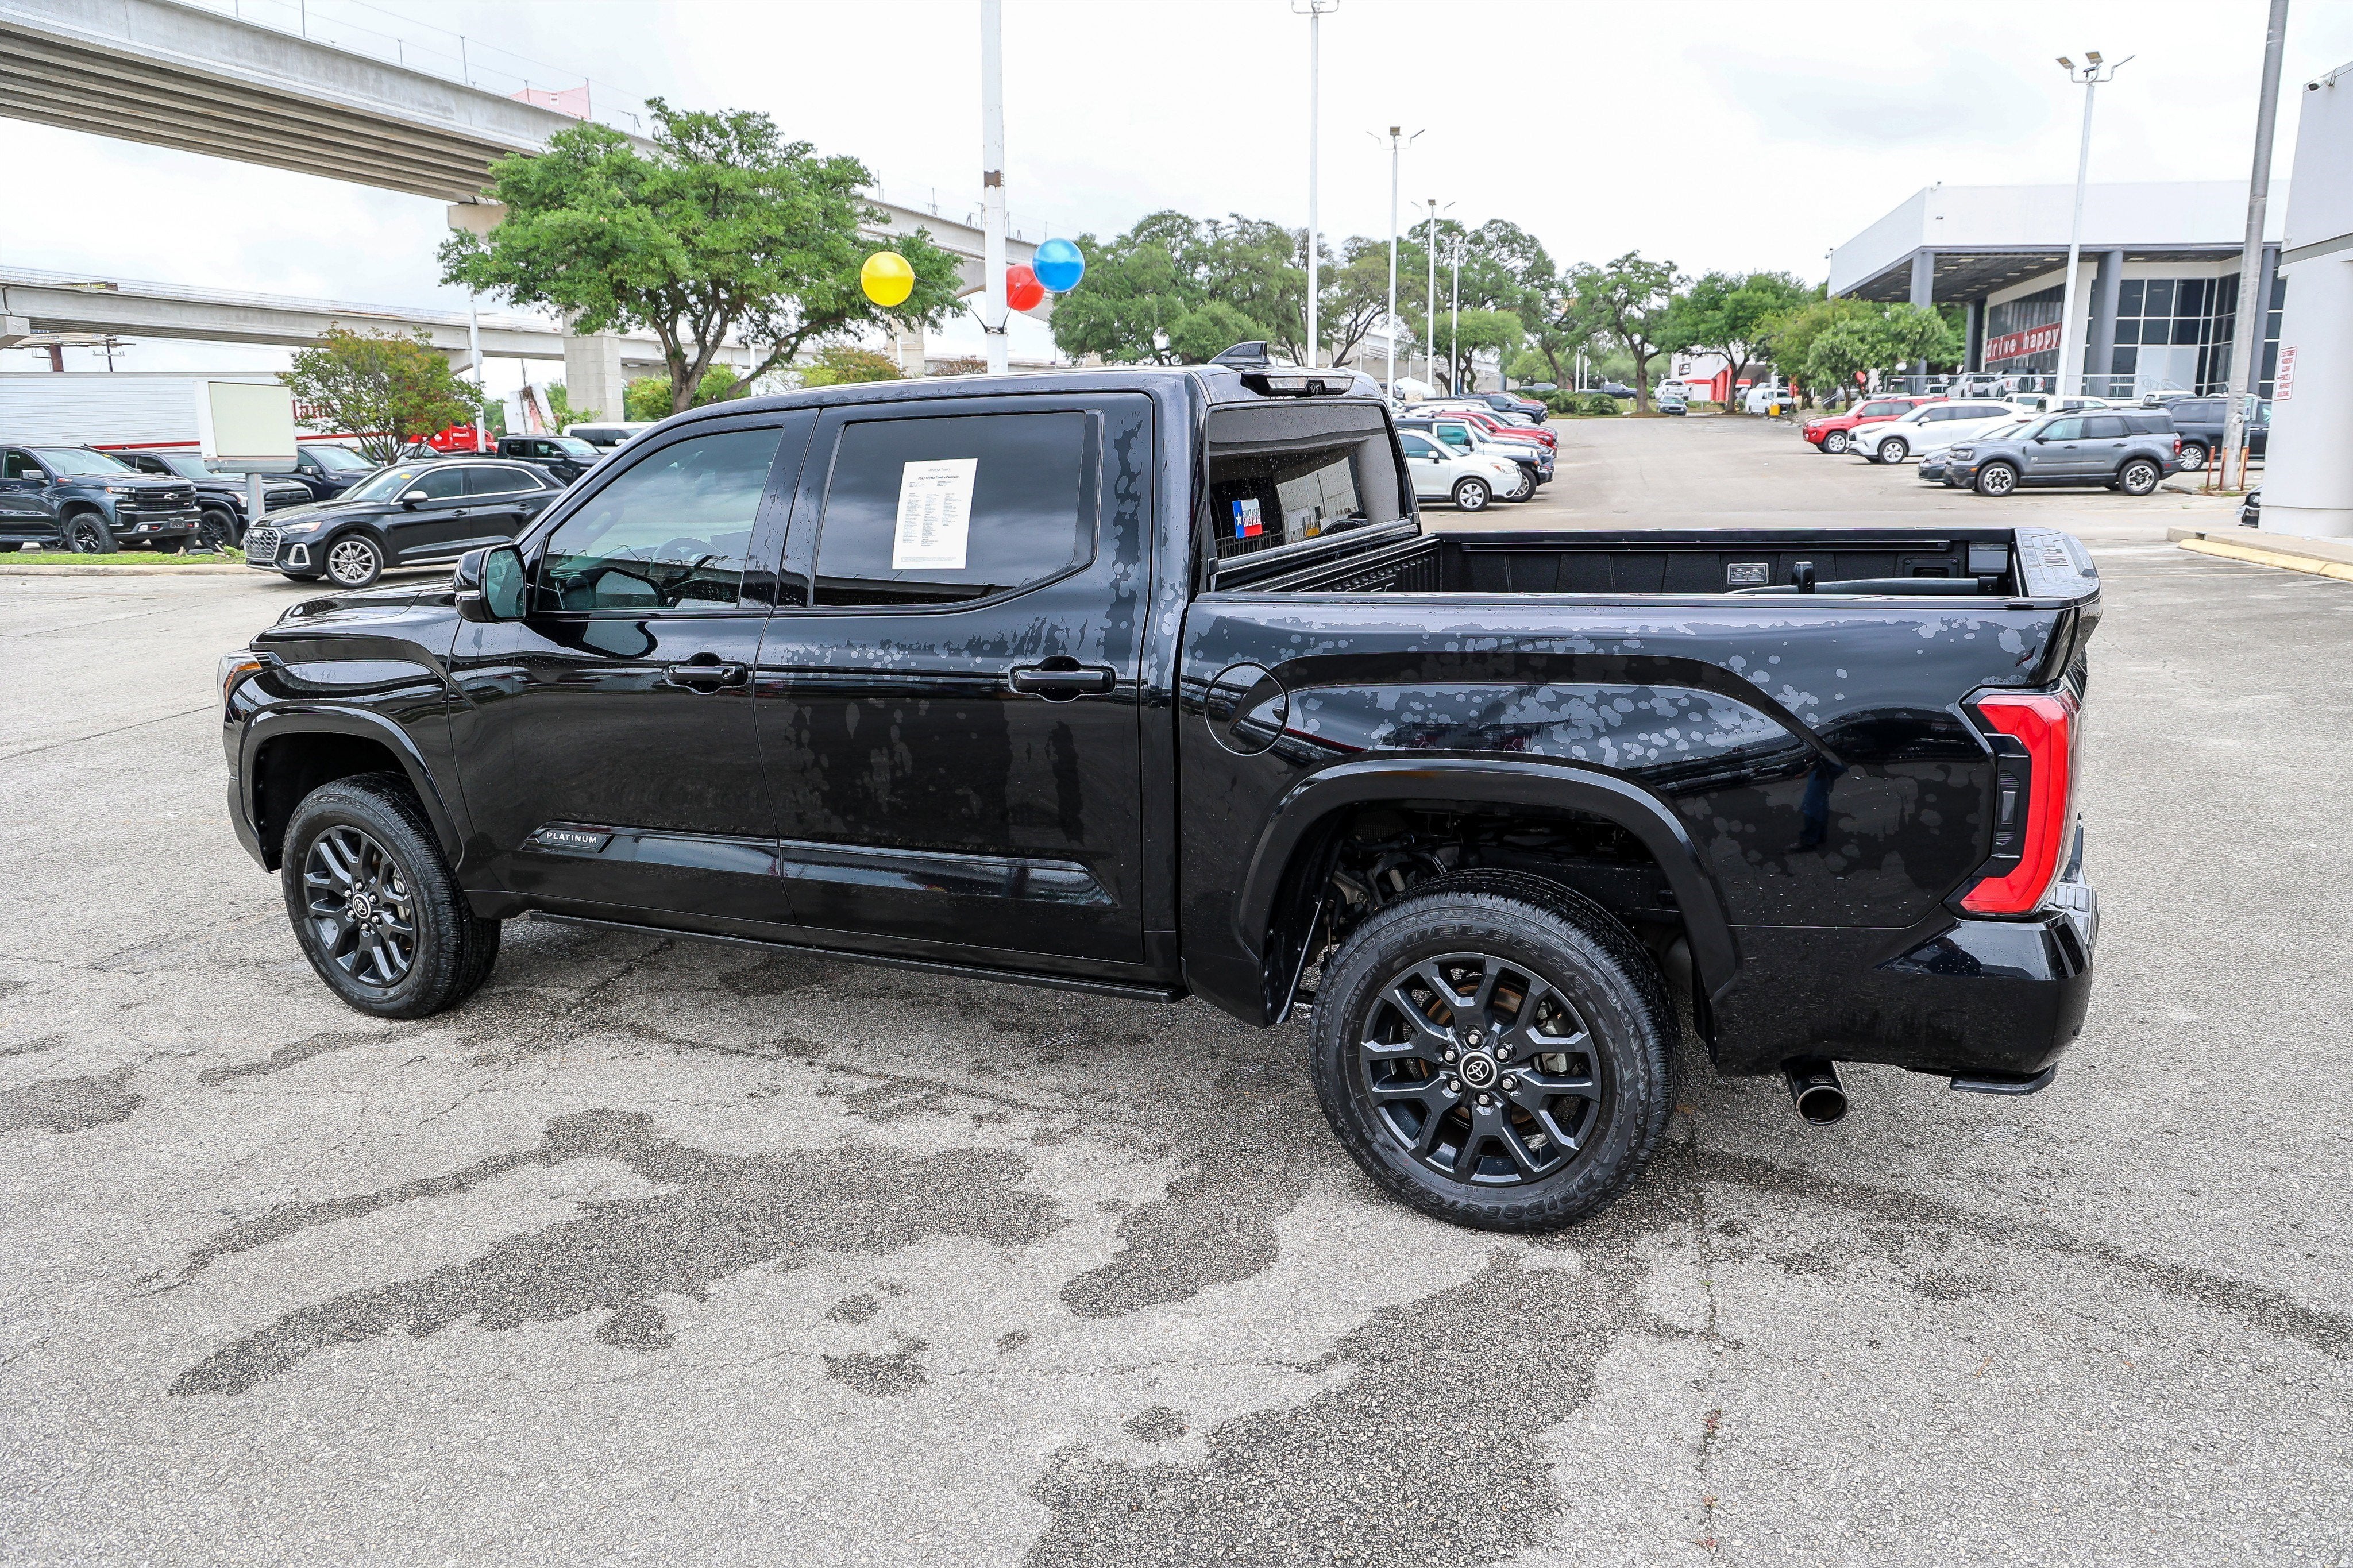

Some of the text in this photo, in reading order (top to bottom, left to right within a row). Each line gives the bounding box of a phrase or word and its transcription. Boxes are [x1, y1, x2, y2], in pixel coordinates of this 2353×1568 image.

[1986, 328, 2059, 357] drive happy
[546, 832, 597, 844] PLATINUM
[1379, 924, 1543, 963] DUELER
[1385, 1167, 1598, 1219] BRIDGESTONE
